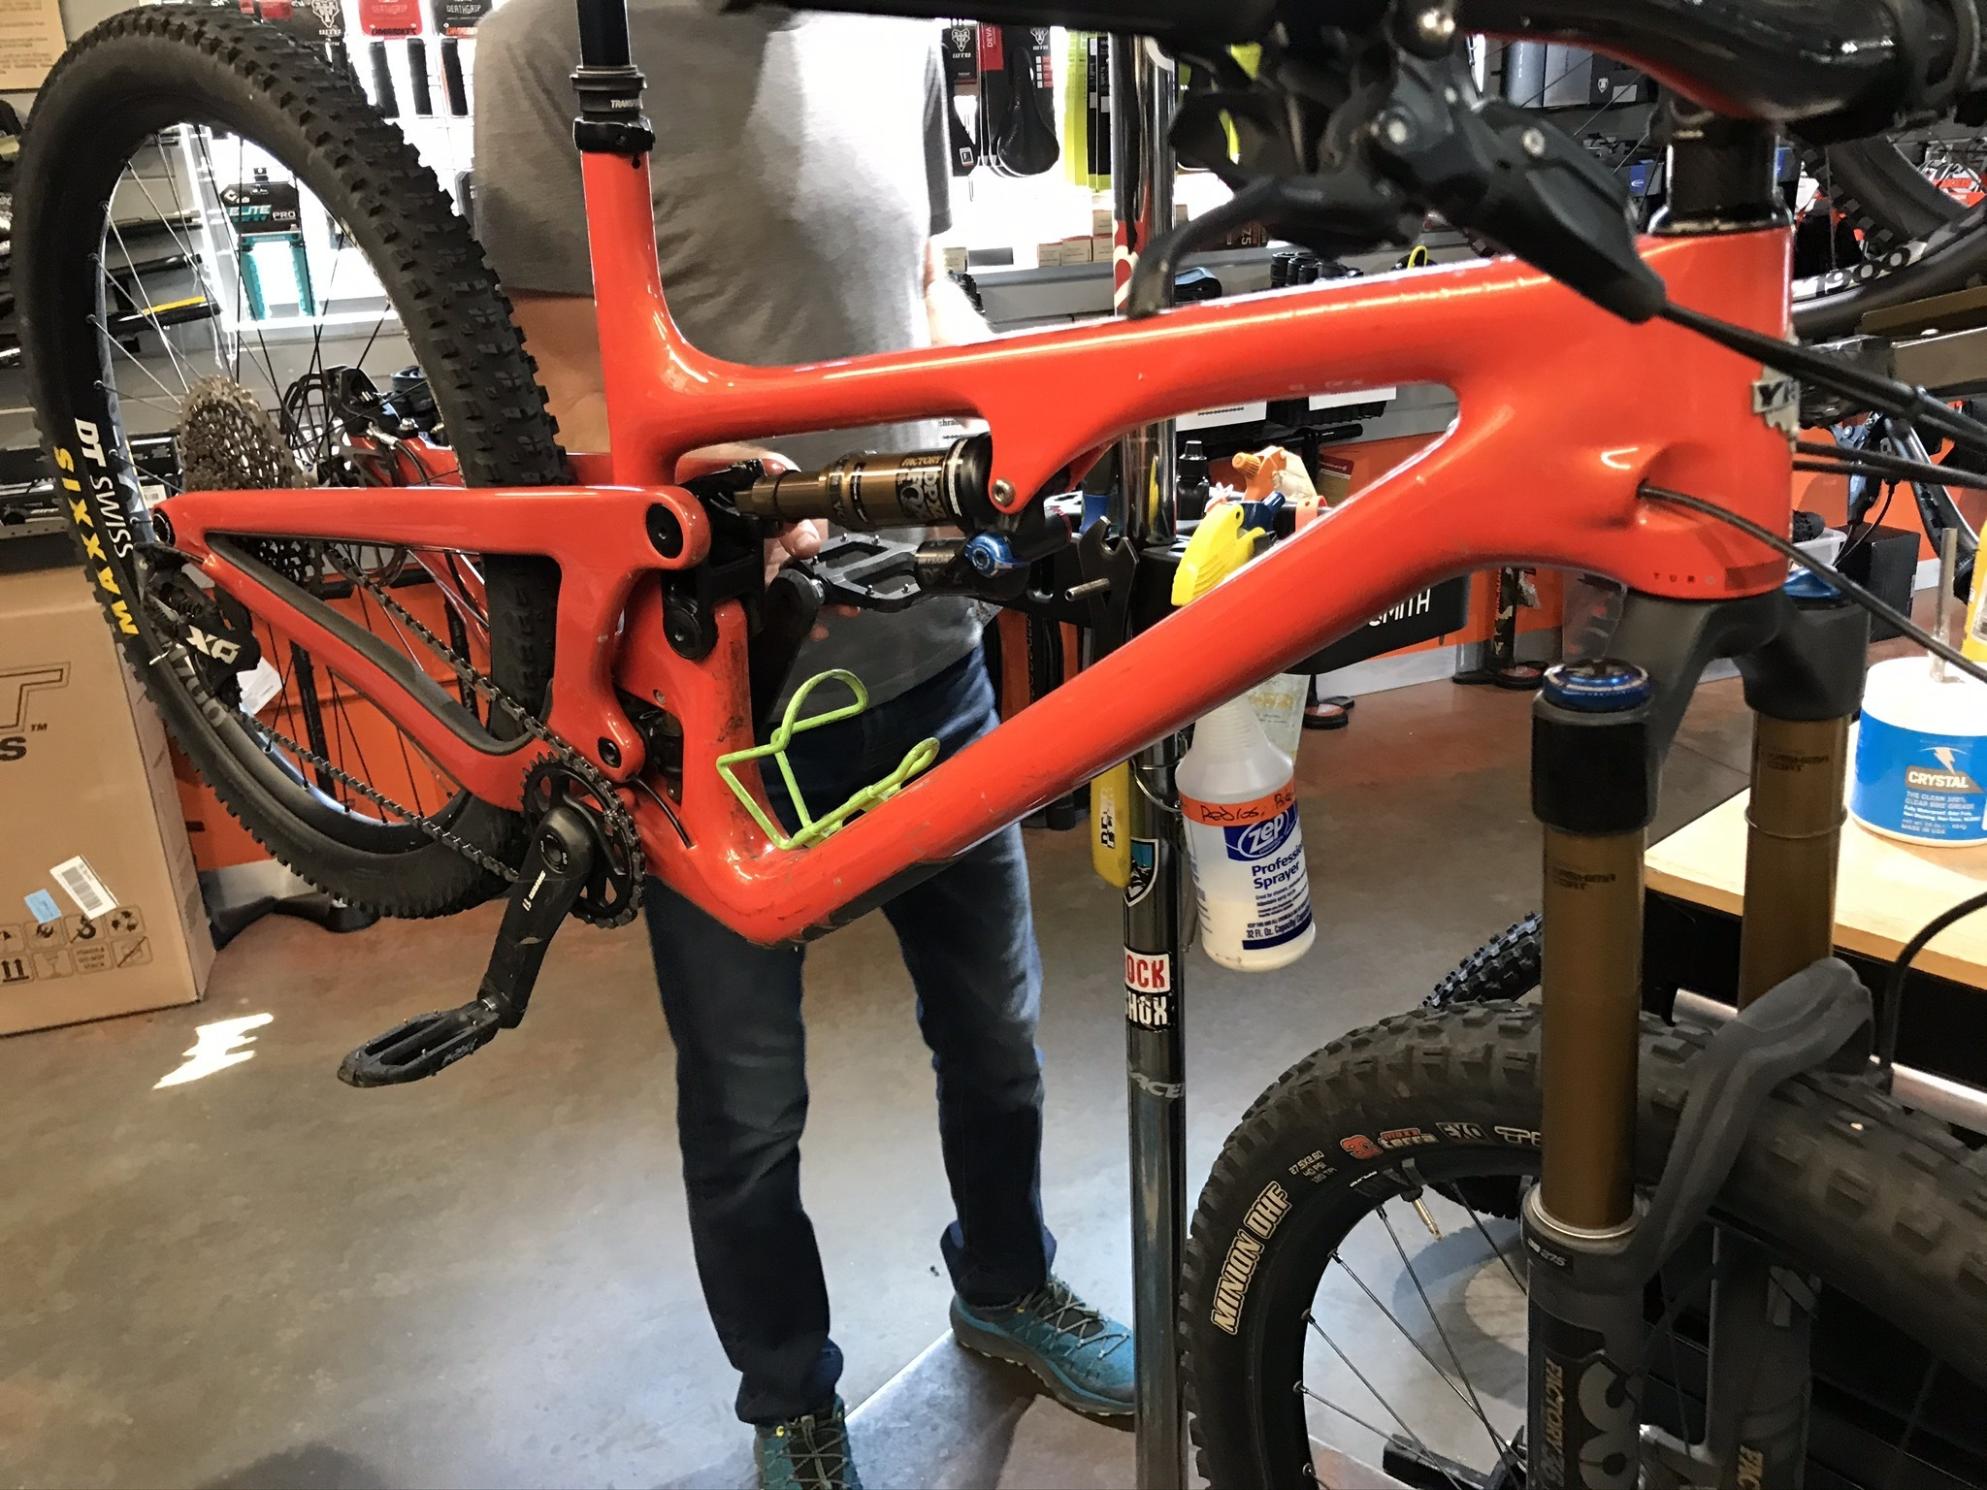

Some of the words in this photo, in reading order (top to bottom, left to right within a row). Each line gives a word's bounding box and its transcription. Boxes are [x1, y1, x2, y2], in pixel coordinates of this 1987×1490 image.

[272, 210, 297, 220] PRO
[74, 418, 107, 468] DT
[89, 474, 134, 559] SWISS
[53, 446, 140, 636] MAXXIS
[1908, 770, 1969, 789] CRYSTAL
[1253, 861, 1300, 890] Sprayer
[1126, 954, 1166, 989] OCK
[1127, 991, 1168, 1026] HOX
[1211, 1228, 1265, 1335] MINION
[1243, 1180, 1293, 1240] DHF
[1545, 1357, 1565, 1440] FACTORY
